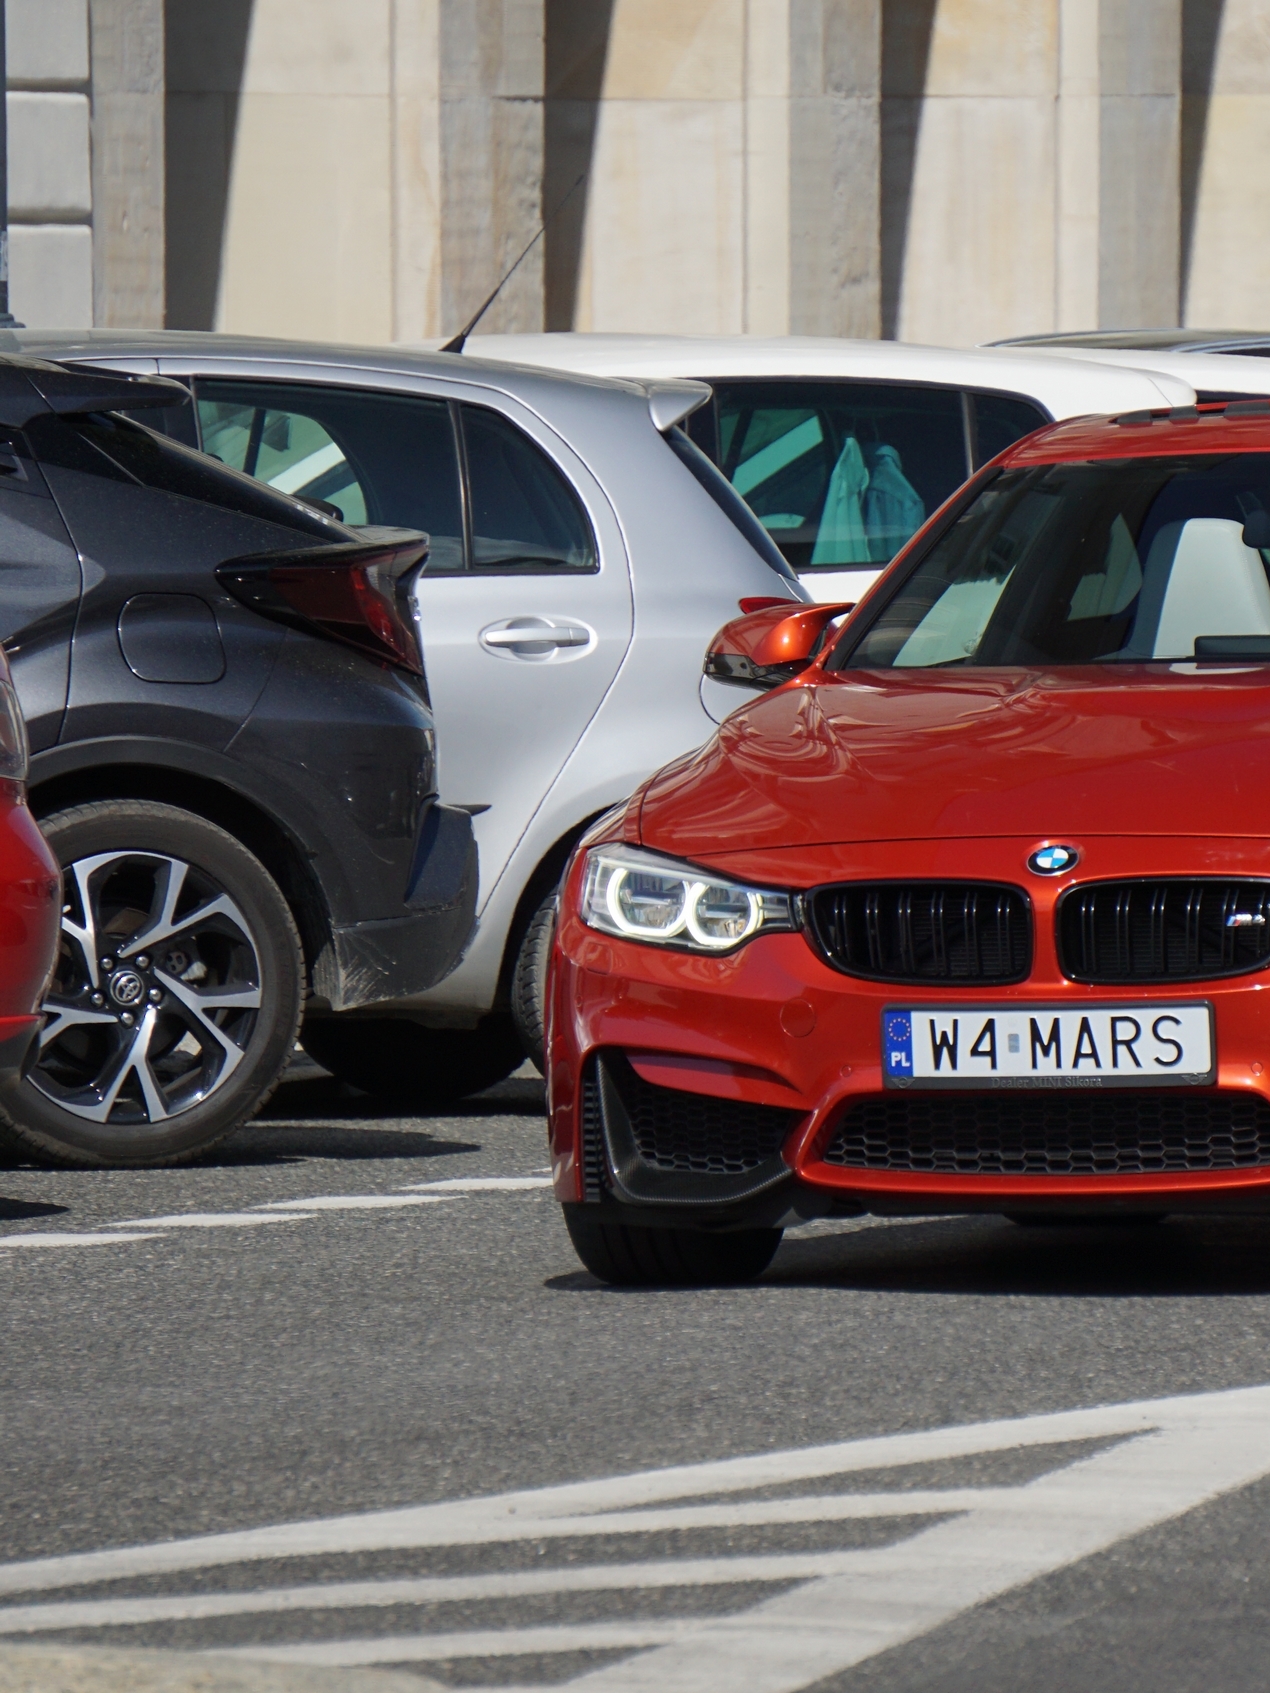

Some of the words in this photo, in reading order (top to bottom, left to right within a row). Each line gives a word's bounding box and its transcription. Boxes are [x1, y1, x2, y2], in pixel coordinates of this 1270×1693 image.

[929, 1018, 998, 1071] W4
[1030, 1015, 1185, 1070] MARS
[891, 1052, 910, 1067] PL
[991, 1077, 1029, 1088] Dealer
[1032, 1076, 1062, 1088] MINI
[1065, 1076, 1103, 1087] Sikora
